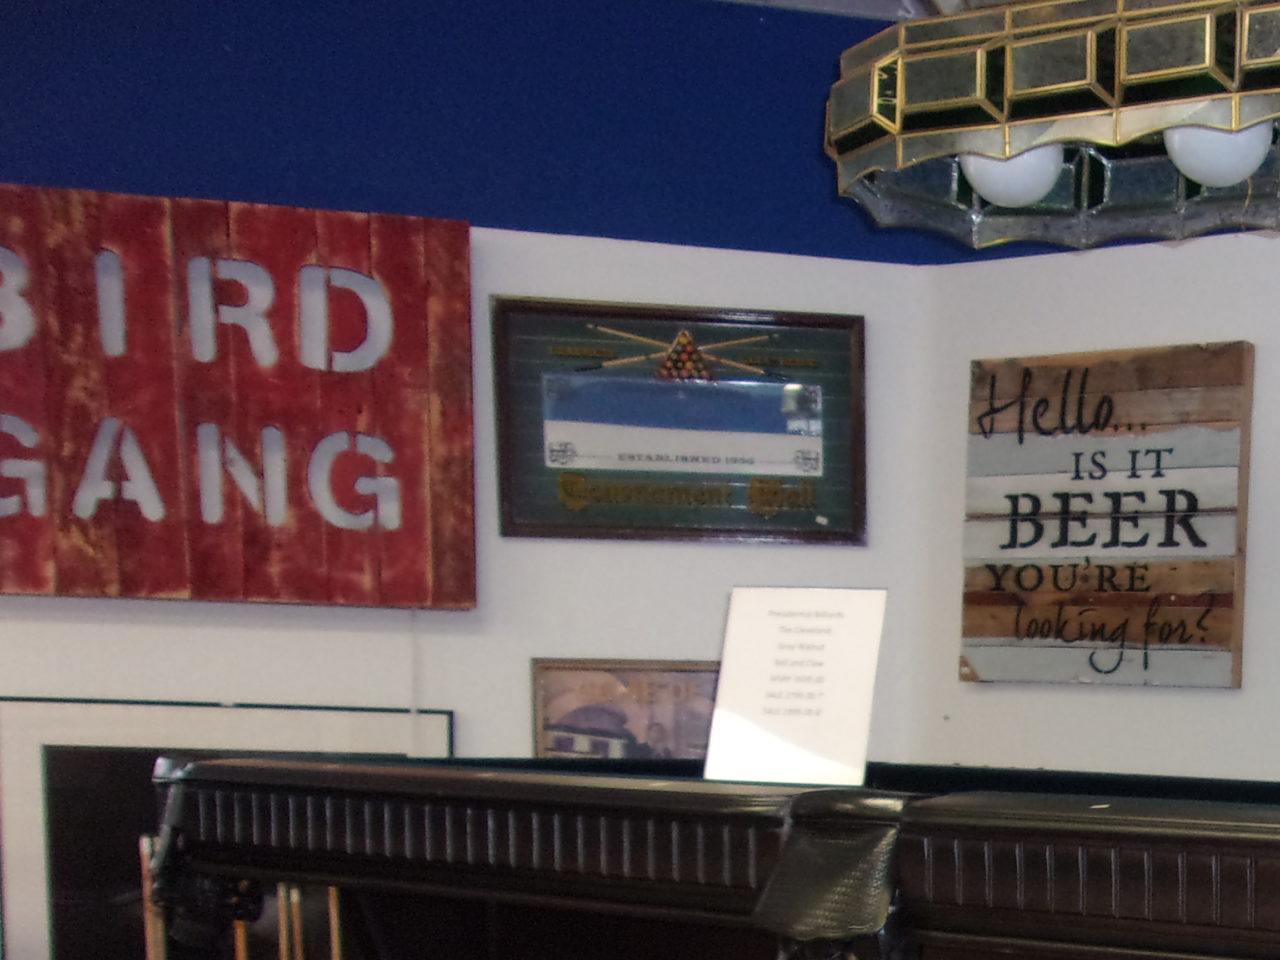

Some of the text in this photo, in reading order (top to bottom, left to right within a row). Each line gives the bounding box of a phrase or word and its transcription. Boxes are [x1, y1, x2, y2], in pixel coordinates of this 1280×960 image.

[0, 413, 402, 531] GANG
[1071, 448, 1174, 480] IS IT
[999, 489, 1207, 549] BEER
[985, 556, 1151, 593] YOU'RE
[1015, 590, 1215, 674] looking for?
